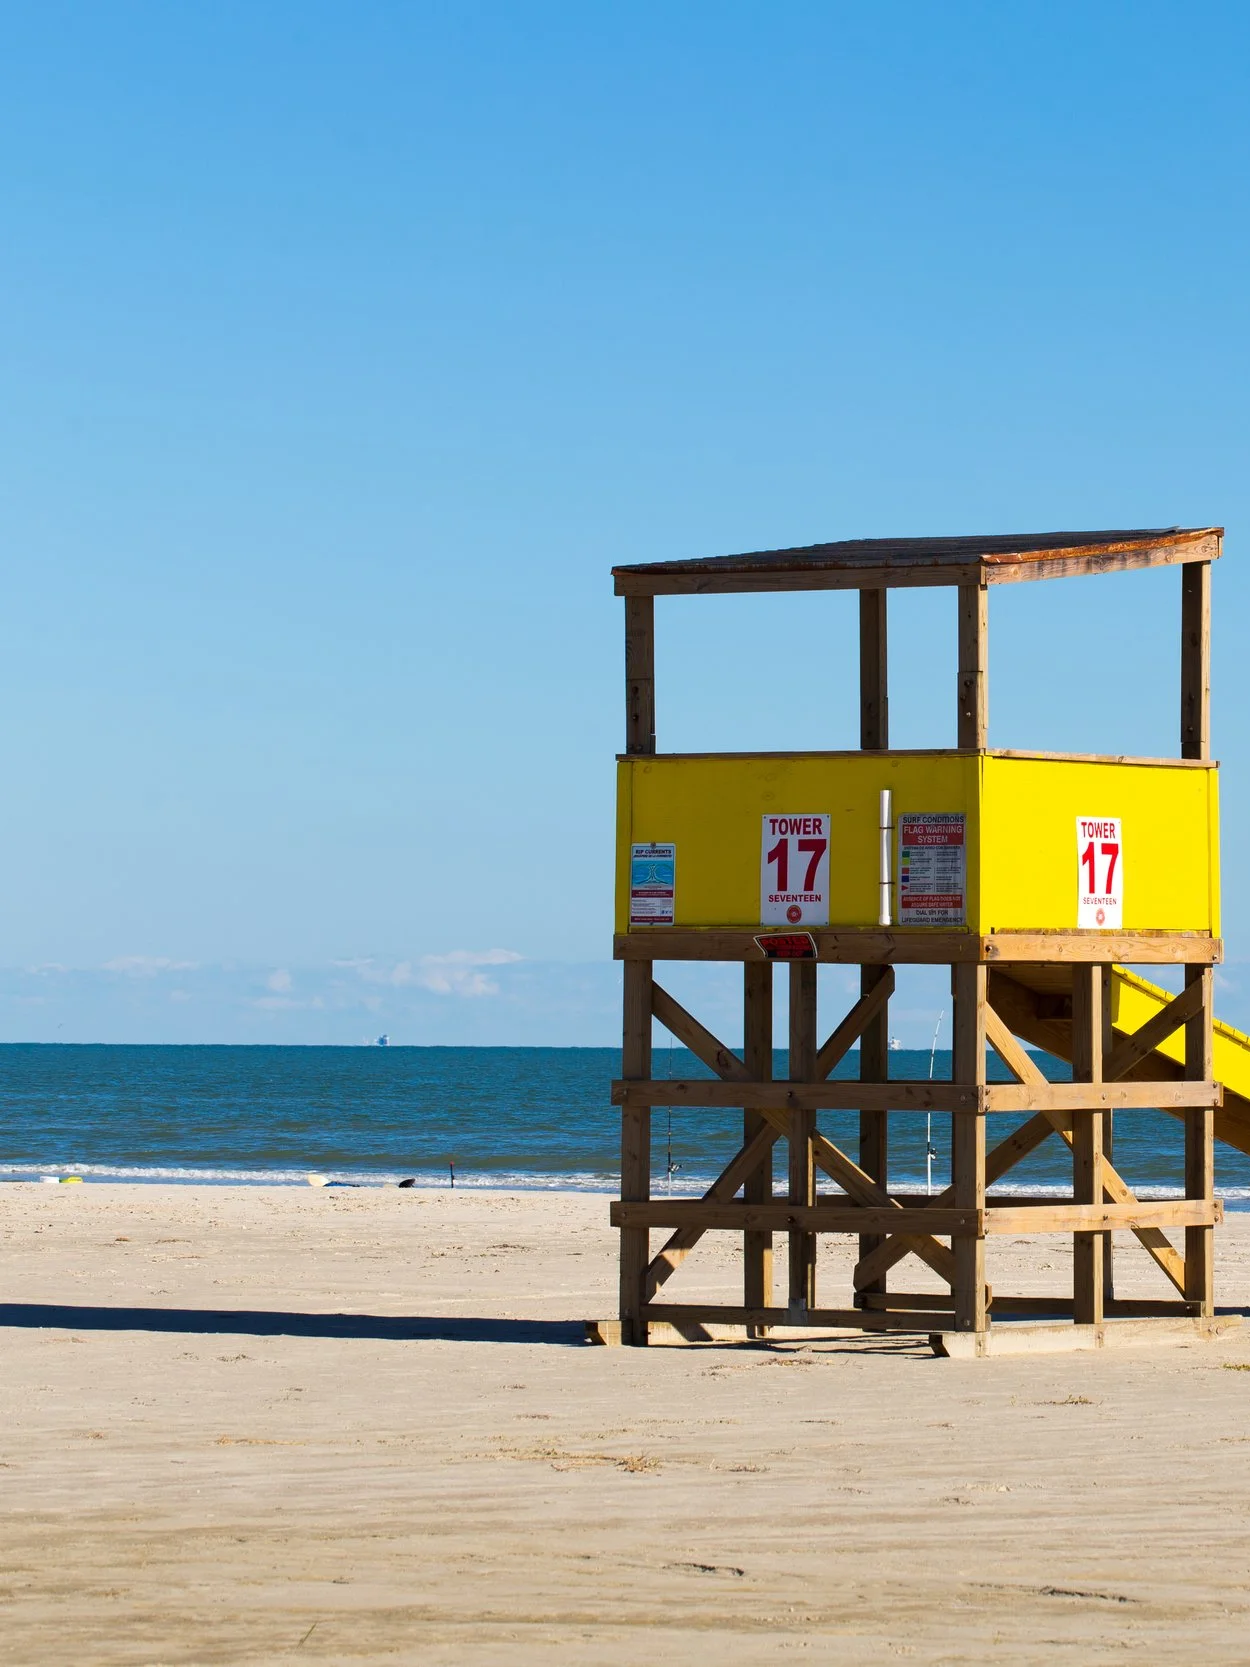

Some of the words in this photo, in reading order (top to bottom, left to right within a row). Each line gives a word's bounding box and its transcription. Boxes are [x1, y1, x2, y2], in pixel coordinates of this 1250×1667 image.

[922, 815, 964, 823] CONDITIONS
[769, 818, 822, 835] TOWER
[903, 825, 924, 834] FLAG
[926, 825, 962, 834] WARNING
[1081, 821, 1116, 838] TOWER
[917, 835, 948, 843] SYSTEM
[767, 838, 827, 891] 17
[1082, 841, 1119, 894] 17
[768, 894, 822, 903] SEVENTEEN
[1083, 896, 1117, 905] SEVENTEEN
